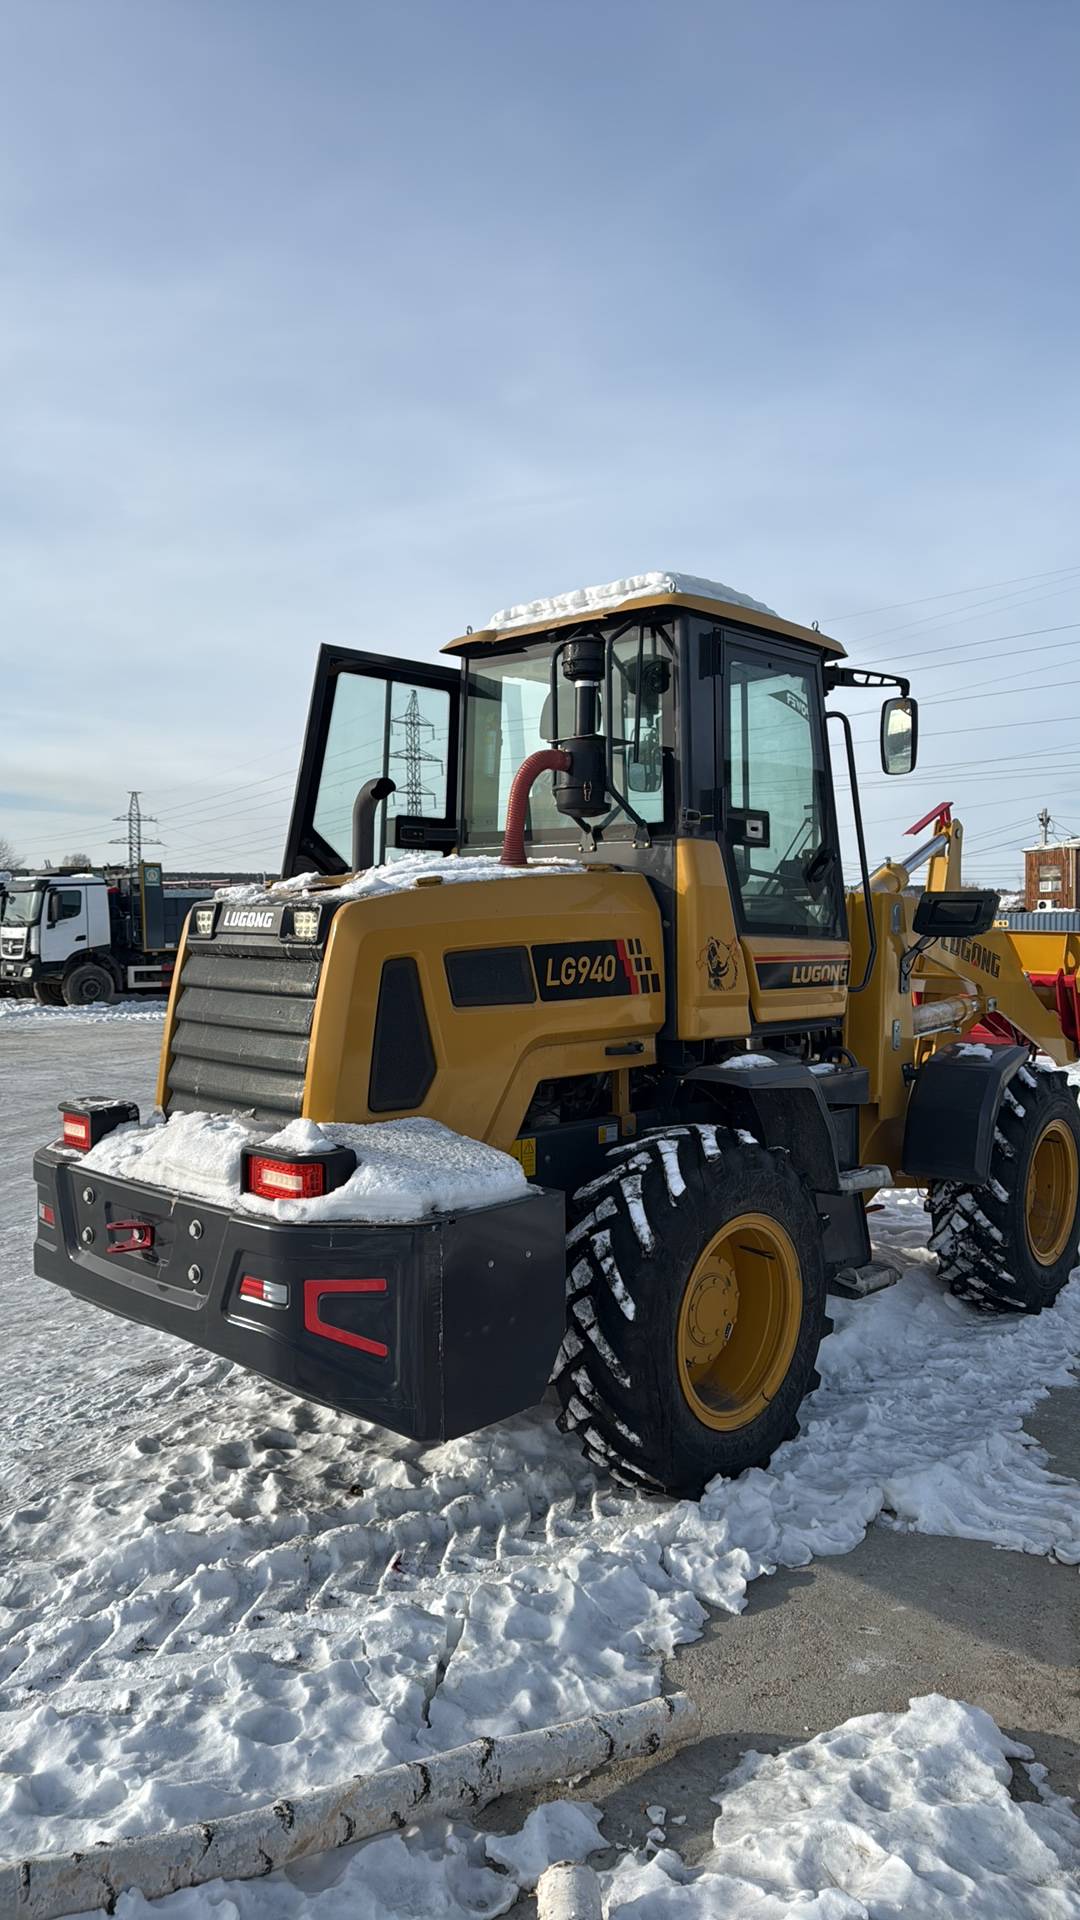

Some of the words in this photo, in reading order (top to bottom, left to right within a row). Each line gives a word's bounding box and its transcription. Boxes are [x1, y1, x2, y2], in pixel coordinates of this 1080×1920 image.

[223, 911, 274, 928] LUGONG
[546, 954, 616, 986] LG940
[792, 964, 848, 984] LUGONG
